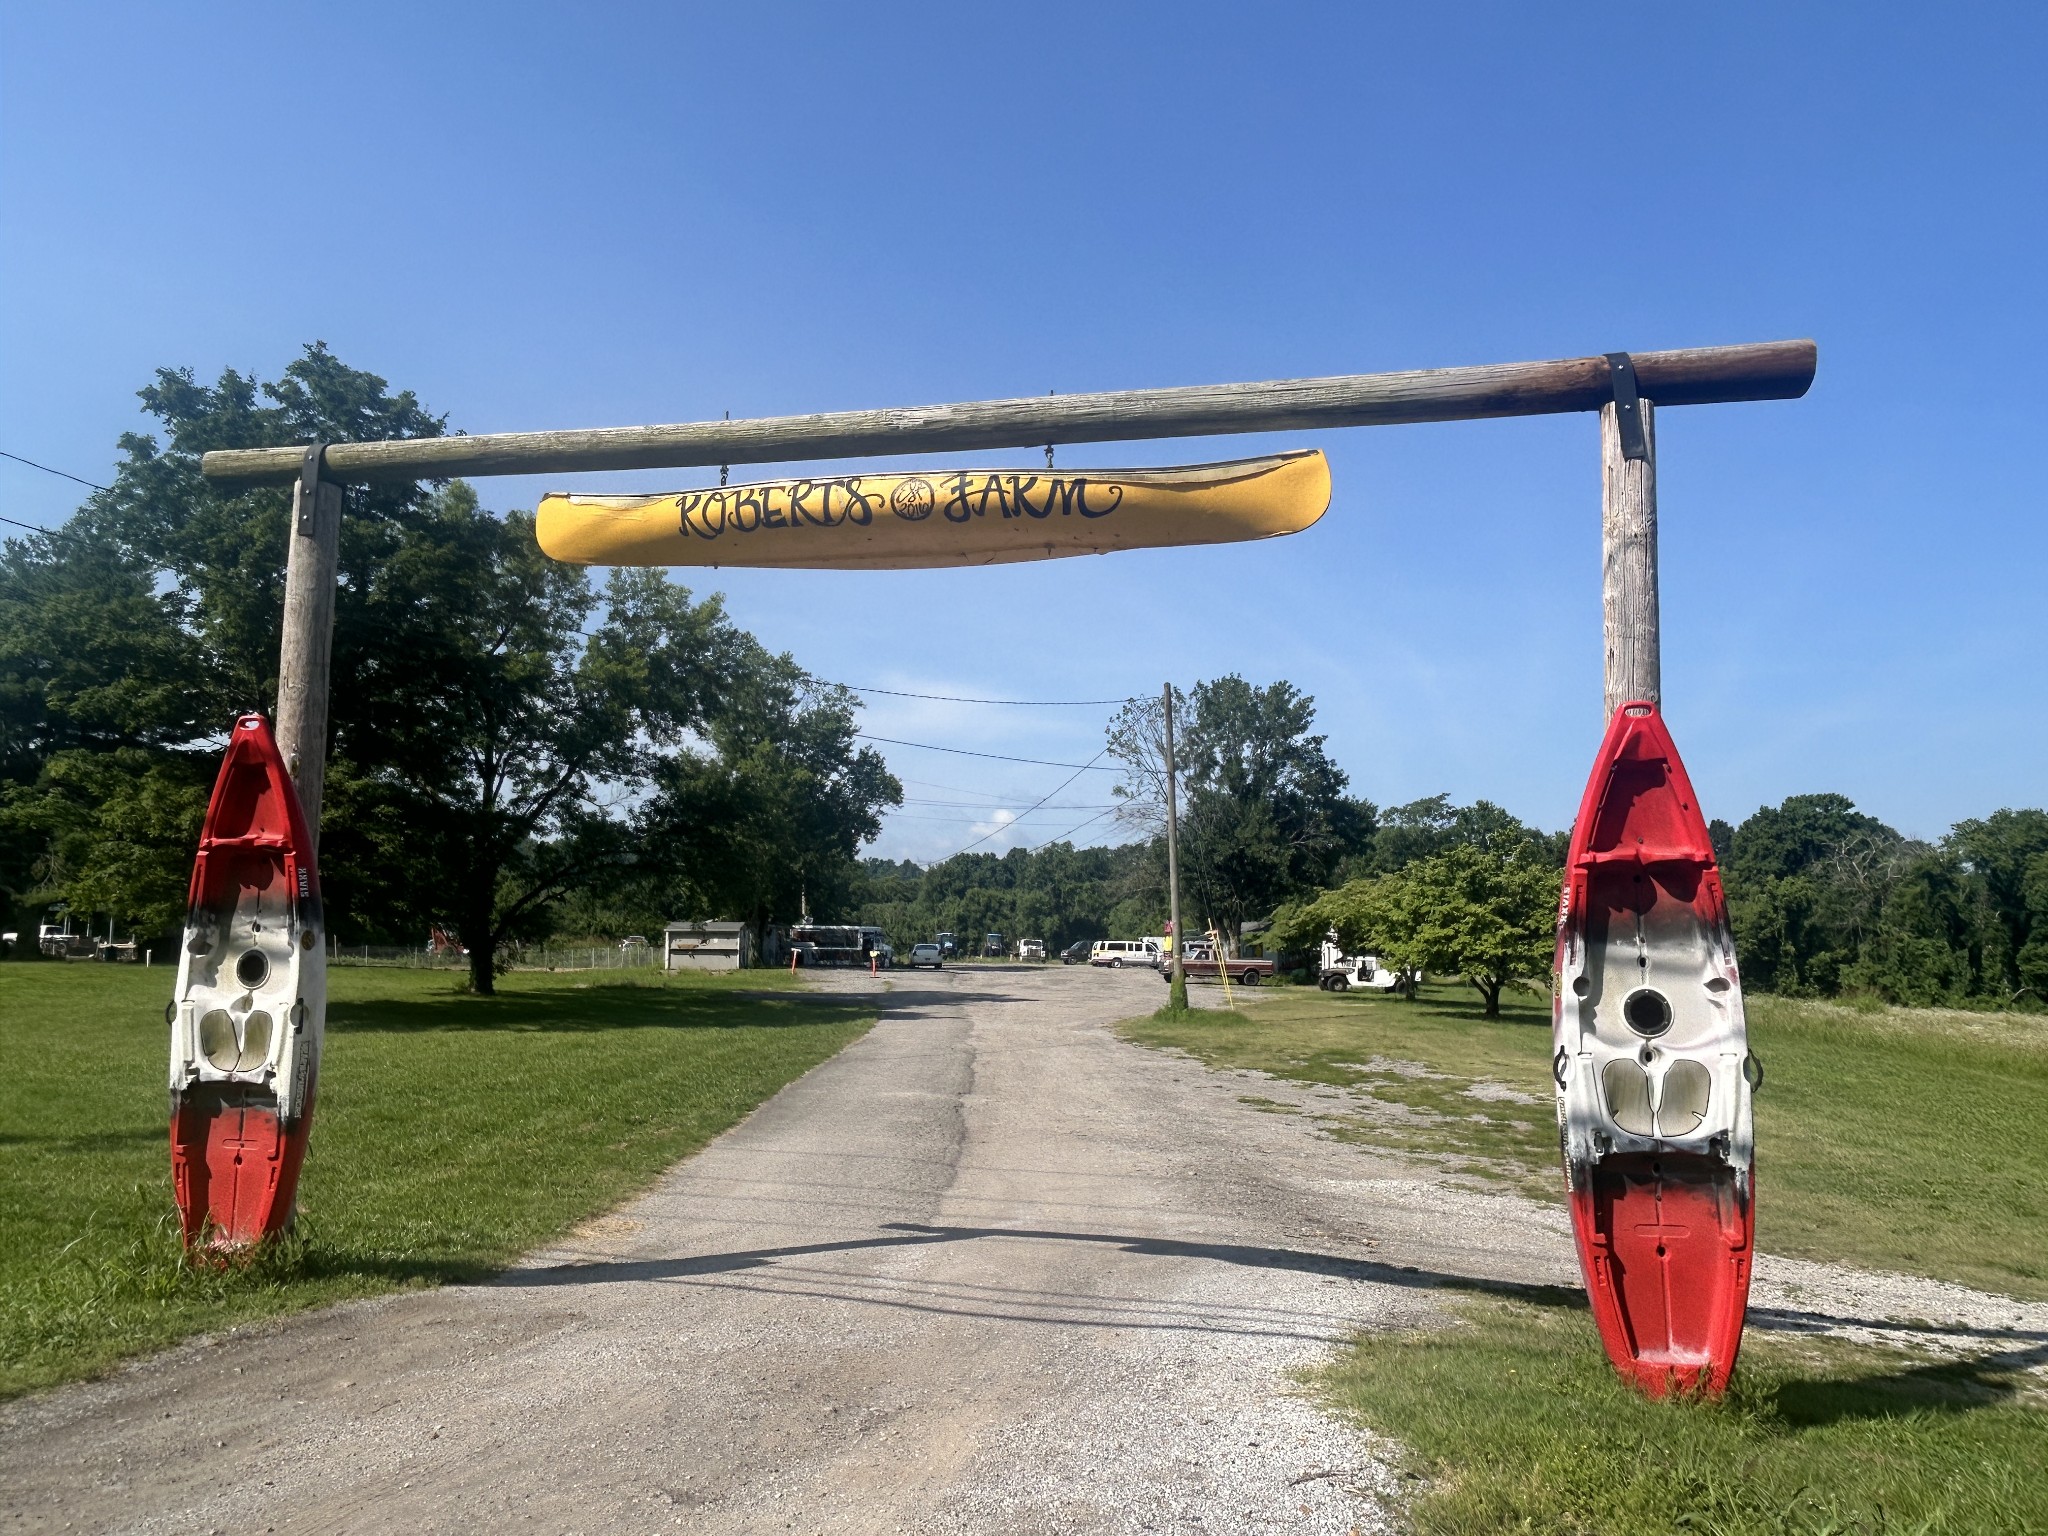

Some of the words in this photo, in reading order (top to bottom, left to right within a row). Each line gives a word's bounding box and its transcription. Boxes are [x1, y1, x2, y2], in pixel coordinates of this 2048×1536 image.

[676, 477, 885, 540] ROBERTS
[940, 472, 1122, 523] FARM
[899, 502, 930, 518] 2016
